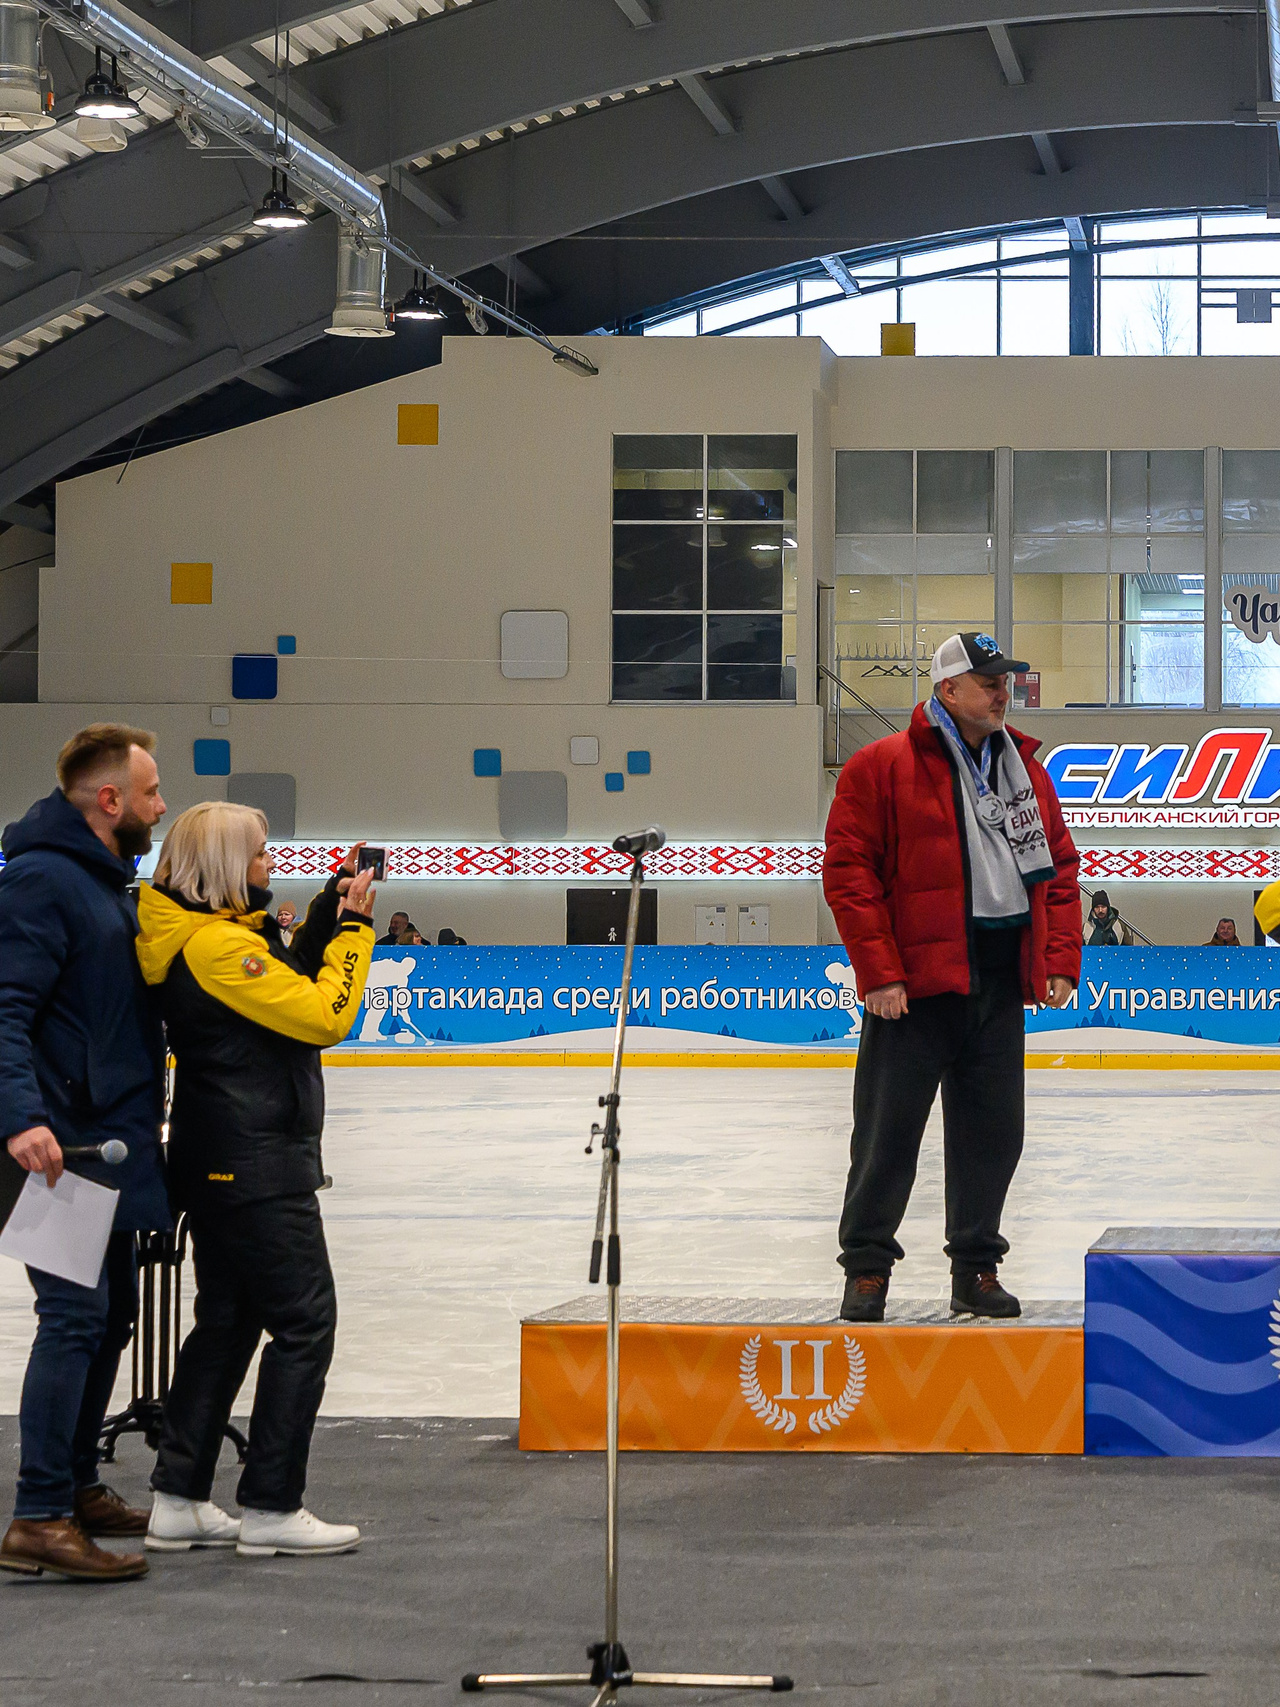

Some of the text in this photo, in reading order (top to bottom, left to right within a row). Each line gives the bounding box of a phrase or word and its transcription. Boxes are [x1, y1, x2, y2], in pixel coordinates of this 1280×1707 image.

[552, 984, 651, 1016] среди
[660, 977, 857, 1016] работников
[773, 1339, 832, 1401] II
